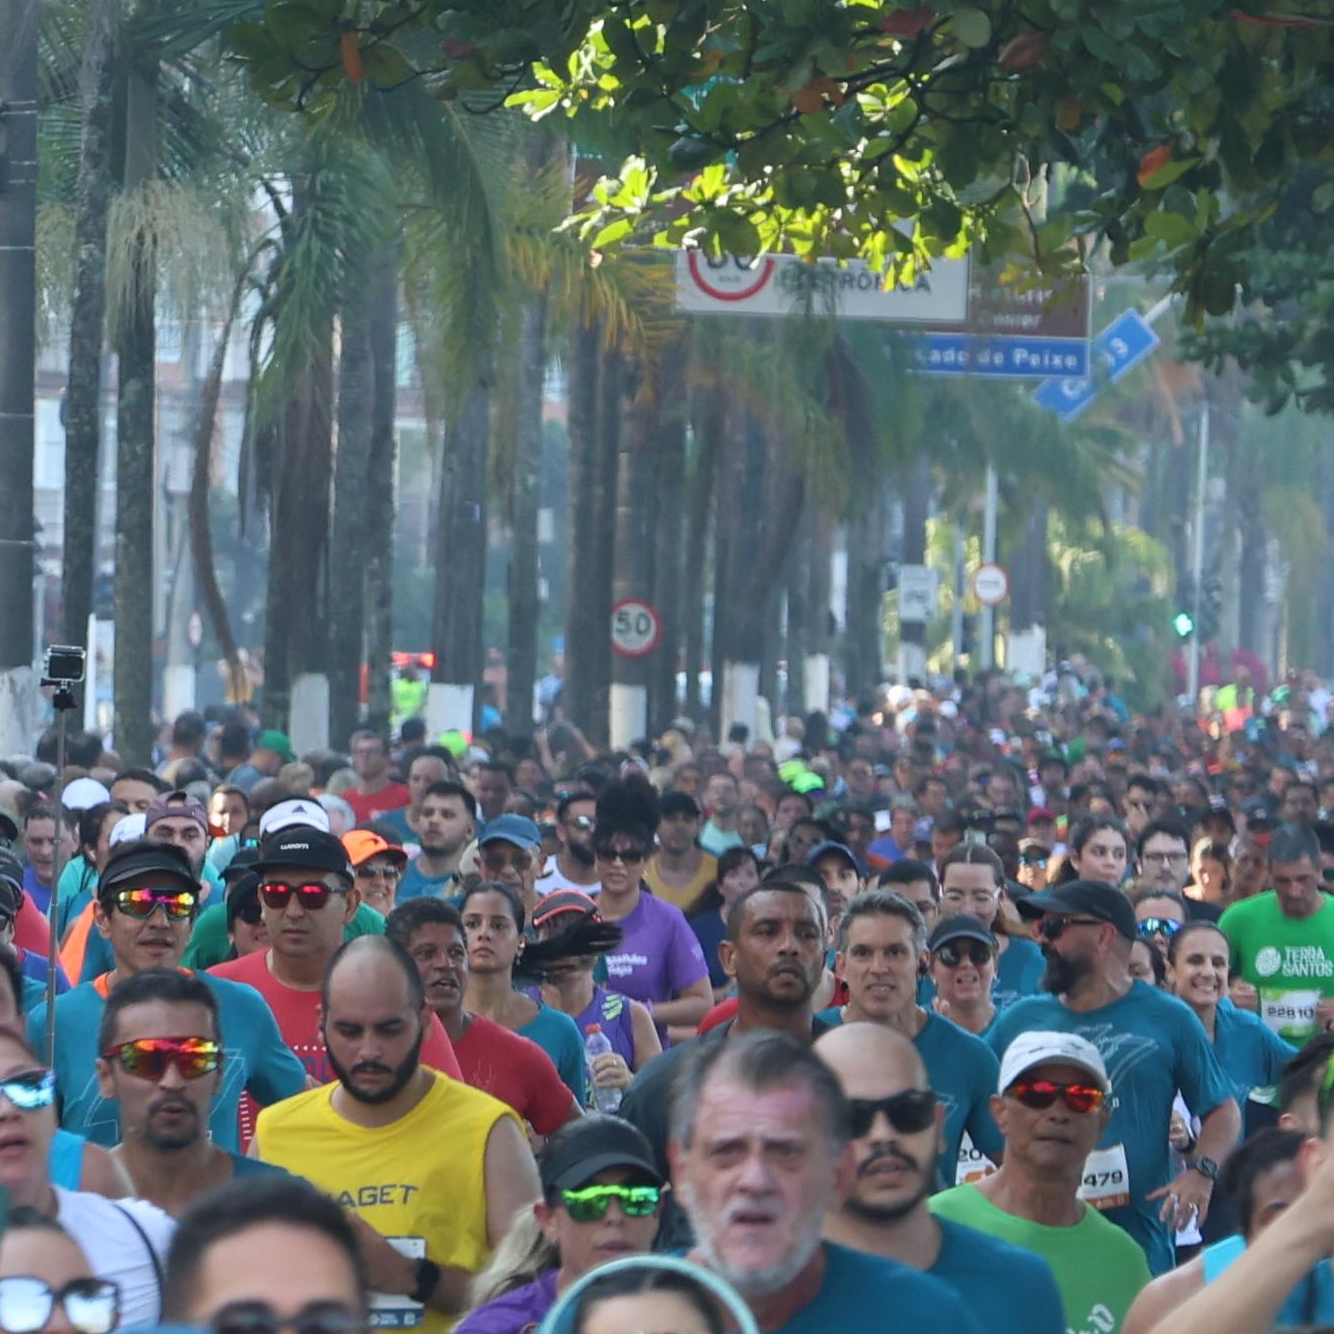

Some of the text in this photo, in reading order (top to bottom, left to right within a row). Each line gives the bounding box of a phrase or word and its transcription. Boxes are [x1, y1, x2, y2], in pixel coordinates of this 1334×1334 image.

[1015, 347, 1079, 367] Peixe
[614, 612, 653, 636] 50
[1282, 960, 1334, 978] SANTOS
[339, 1183, 420, 1208] AGET
